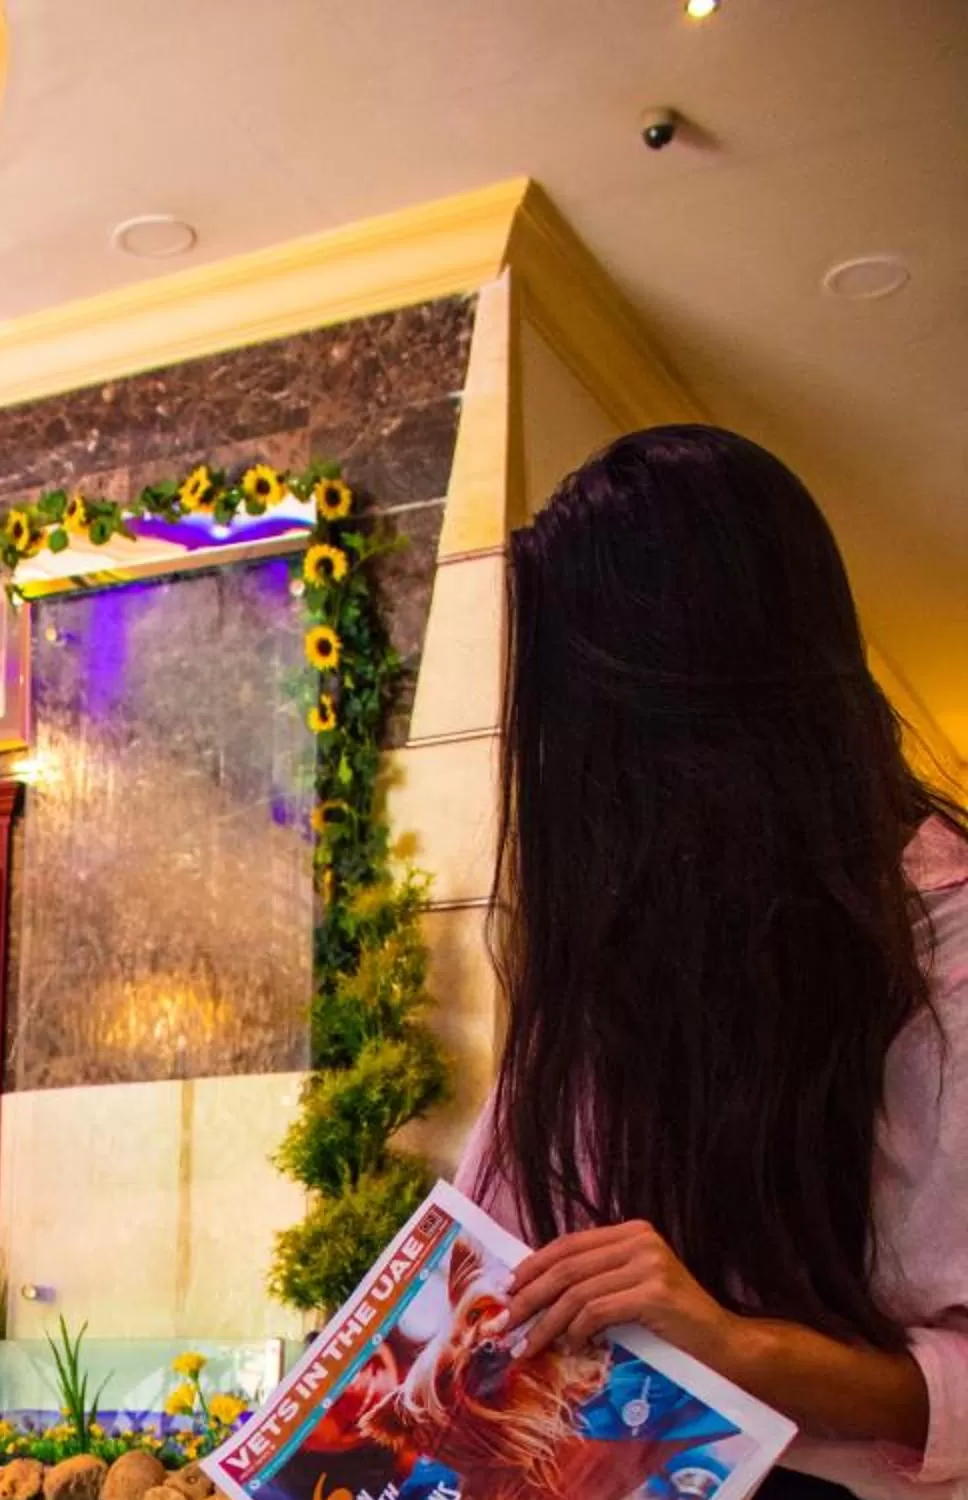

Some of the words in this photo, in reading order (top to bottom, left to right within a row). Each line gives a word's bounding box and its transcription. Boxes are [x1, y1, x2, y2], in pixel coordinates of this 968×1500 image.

[227, 1397, 300, 1471] VETS
[294, 1363, 329, 1398] IN
[323, 1304, 377, 1361] THE
[371, 1235, 425, 1300] UAE
